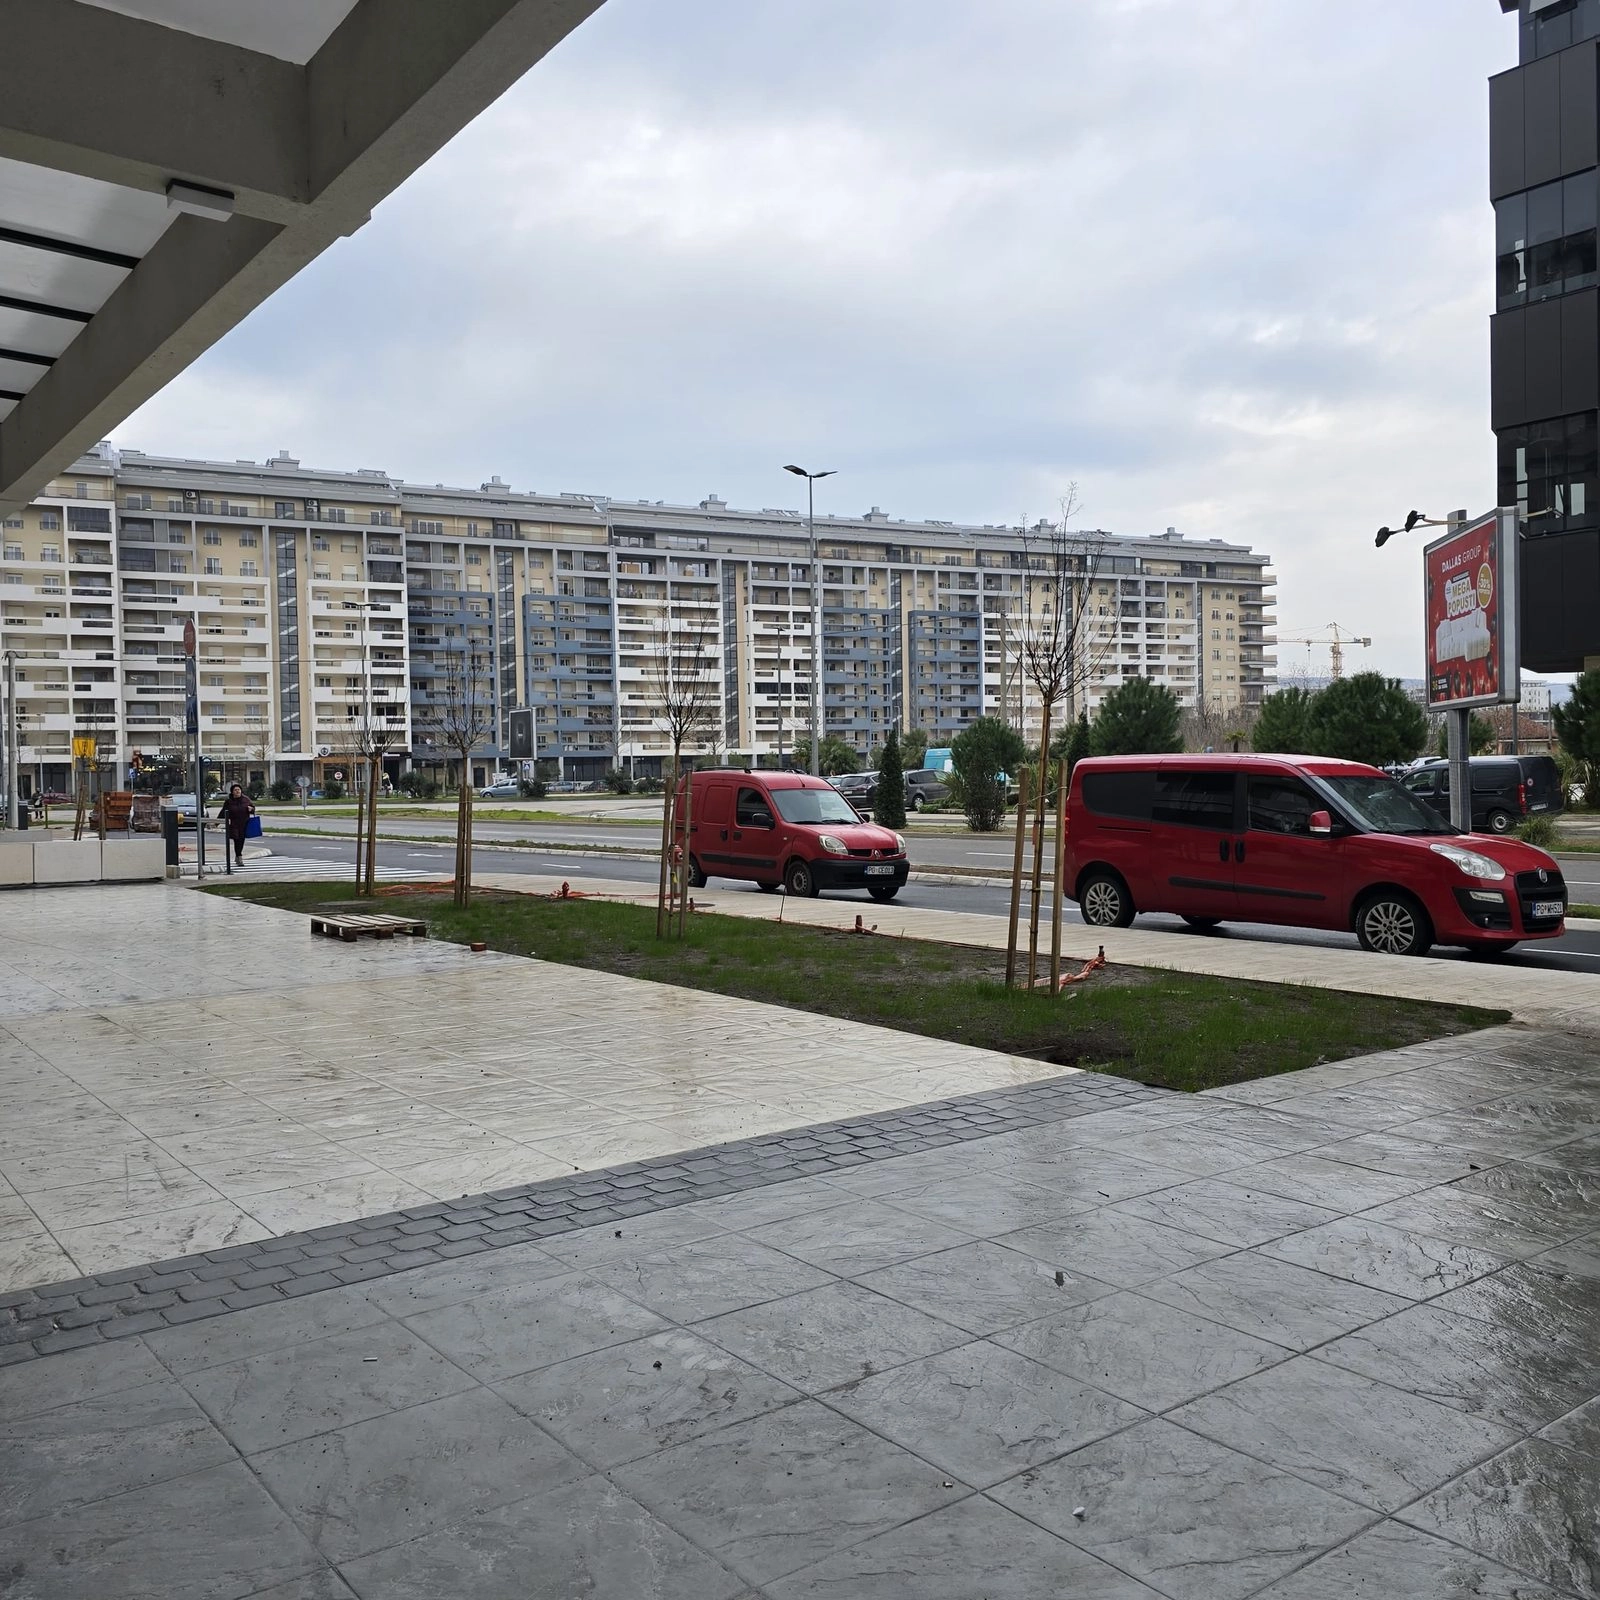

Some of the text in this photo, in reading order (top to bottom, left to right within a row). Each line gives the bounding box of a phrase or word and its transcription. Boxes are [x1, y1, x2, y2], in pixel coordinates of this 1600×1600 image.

[1442, 545, 1481, 573] DALLAS GROUP
[1452, 580, 1471, 597] MEGA
[1448, 592, 1476, 614] POPUSTI
